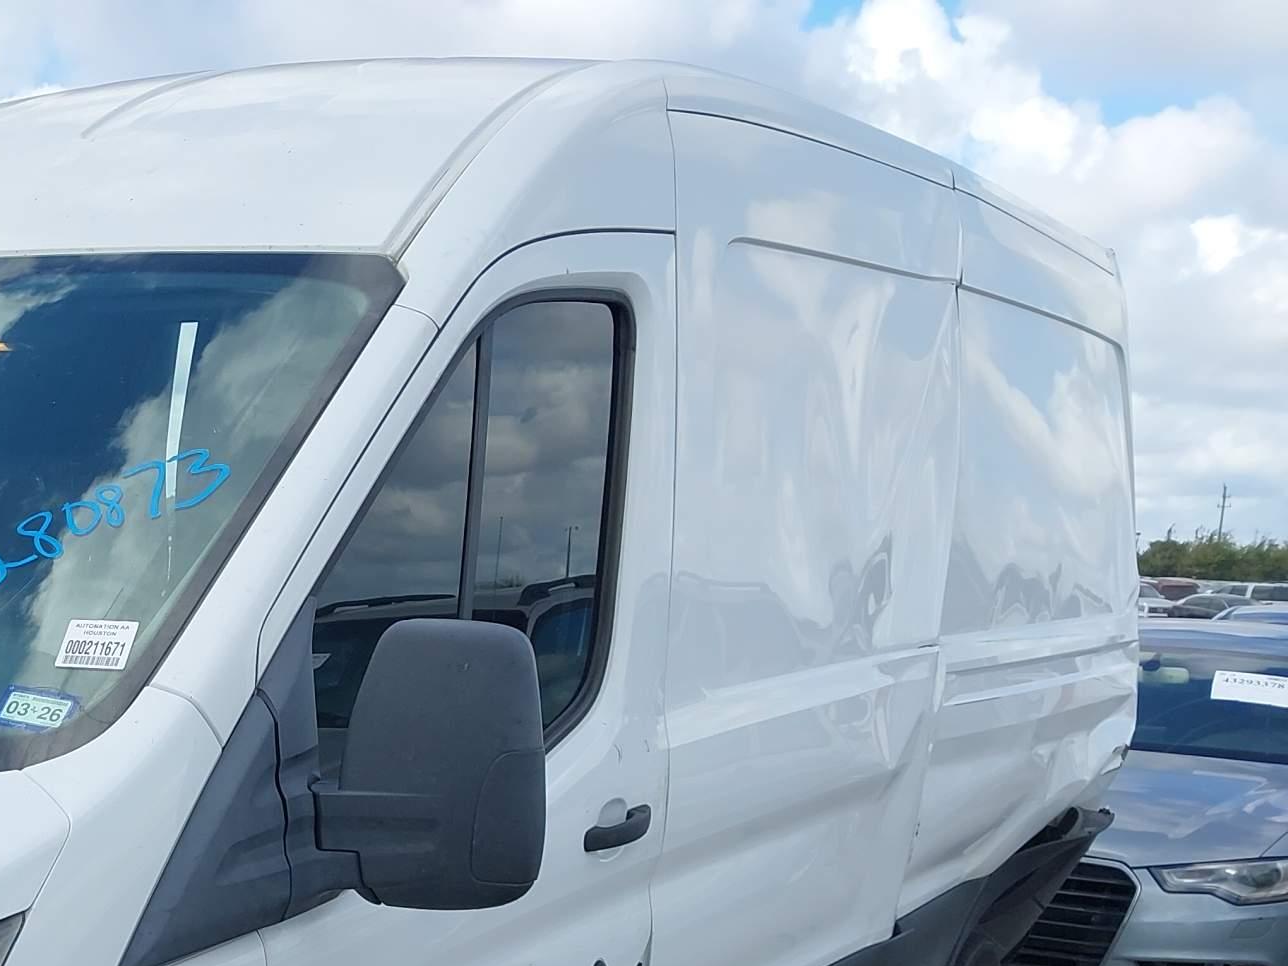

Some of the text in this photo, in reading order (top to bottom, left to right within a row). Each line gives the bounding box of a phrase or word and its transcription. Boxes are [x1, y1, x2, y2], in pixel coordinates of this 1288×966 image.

[65, 639, 126, 656] 000211671
[6, 700, 31, 716] 03
[36, 706, 63, 722] 26
